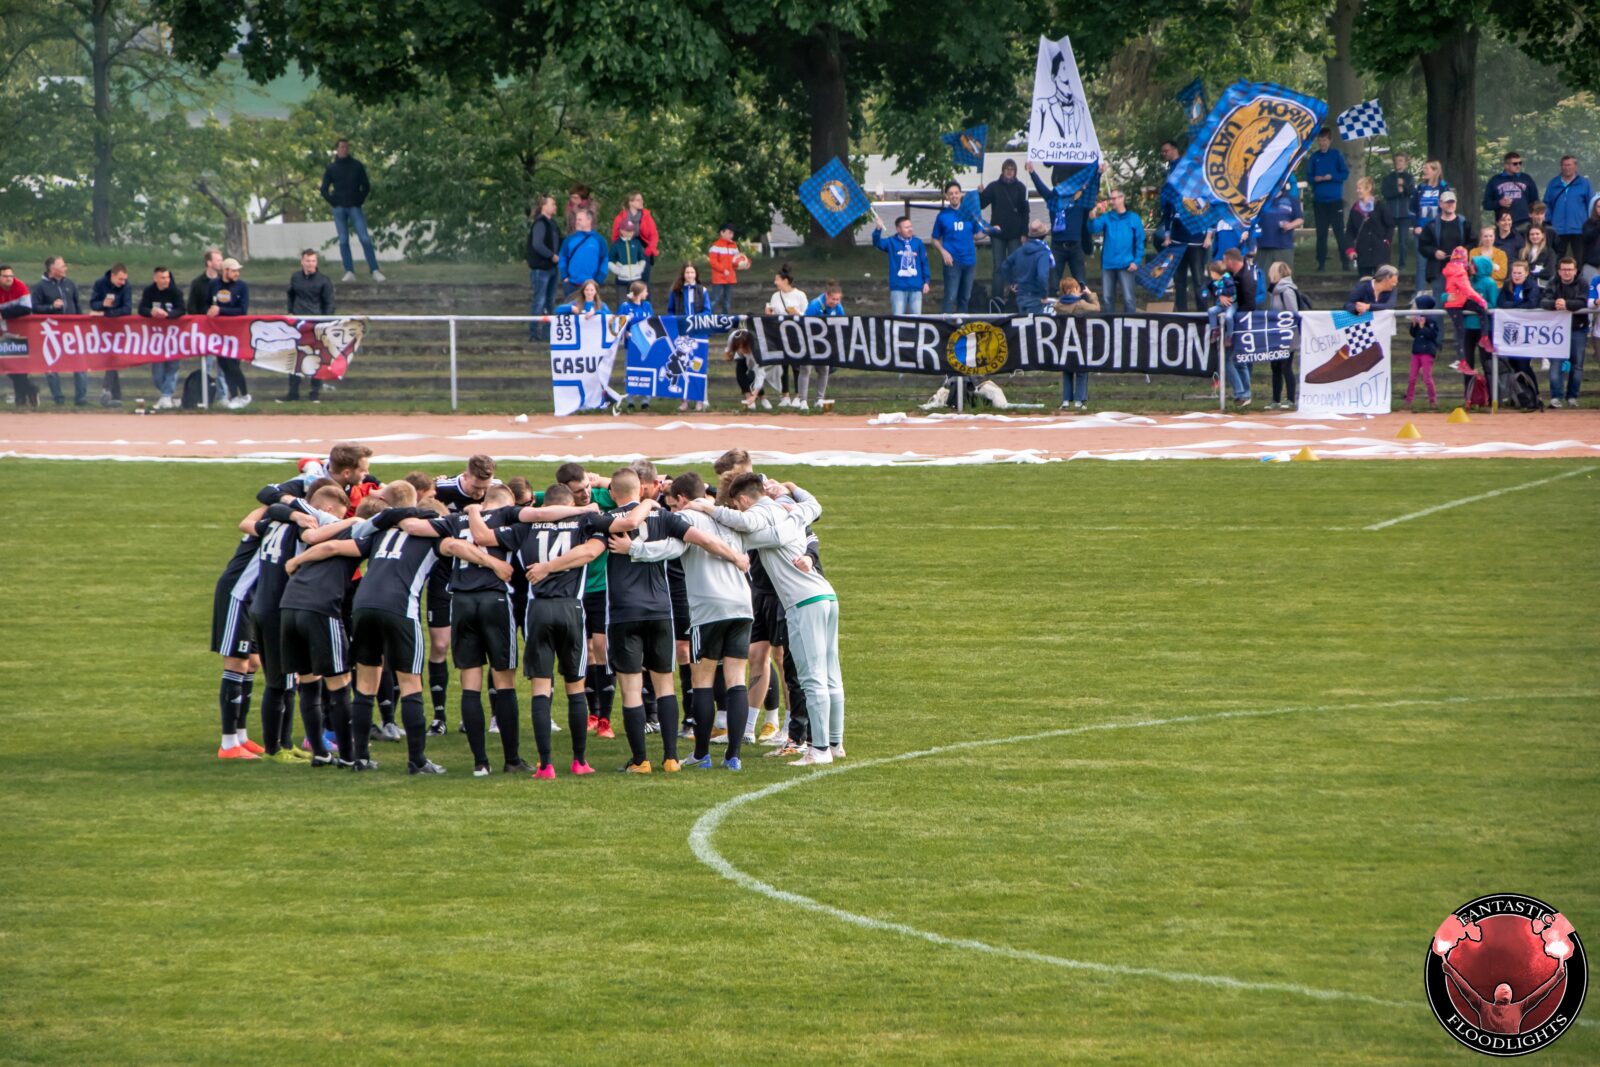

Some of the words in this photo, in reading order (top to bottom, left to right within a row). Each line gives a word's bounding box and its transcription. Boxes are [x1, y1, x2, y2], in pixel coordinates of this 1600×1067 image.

[1049, 141, 1082, 149] OSKAR
[954, 221, 963, 231] 10
[556, 315, 571, 327] 18
[556, 327, 573, 341] 93
[40, 318, 239, 366] Feldschlößchen
[753, 315, 941, 371] LÖBTAUER
[1011, 313, 1211, 371] TRADITION
[1523, 325, 1564, 345] FS6
[553, 356, 603, 374] CASU
[1349, 371, 1389, 409] HOT!
[374, 527, 409, 560] 11
[536, 531, 571, 571] 14
